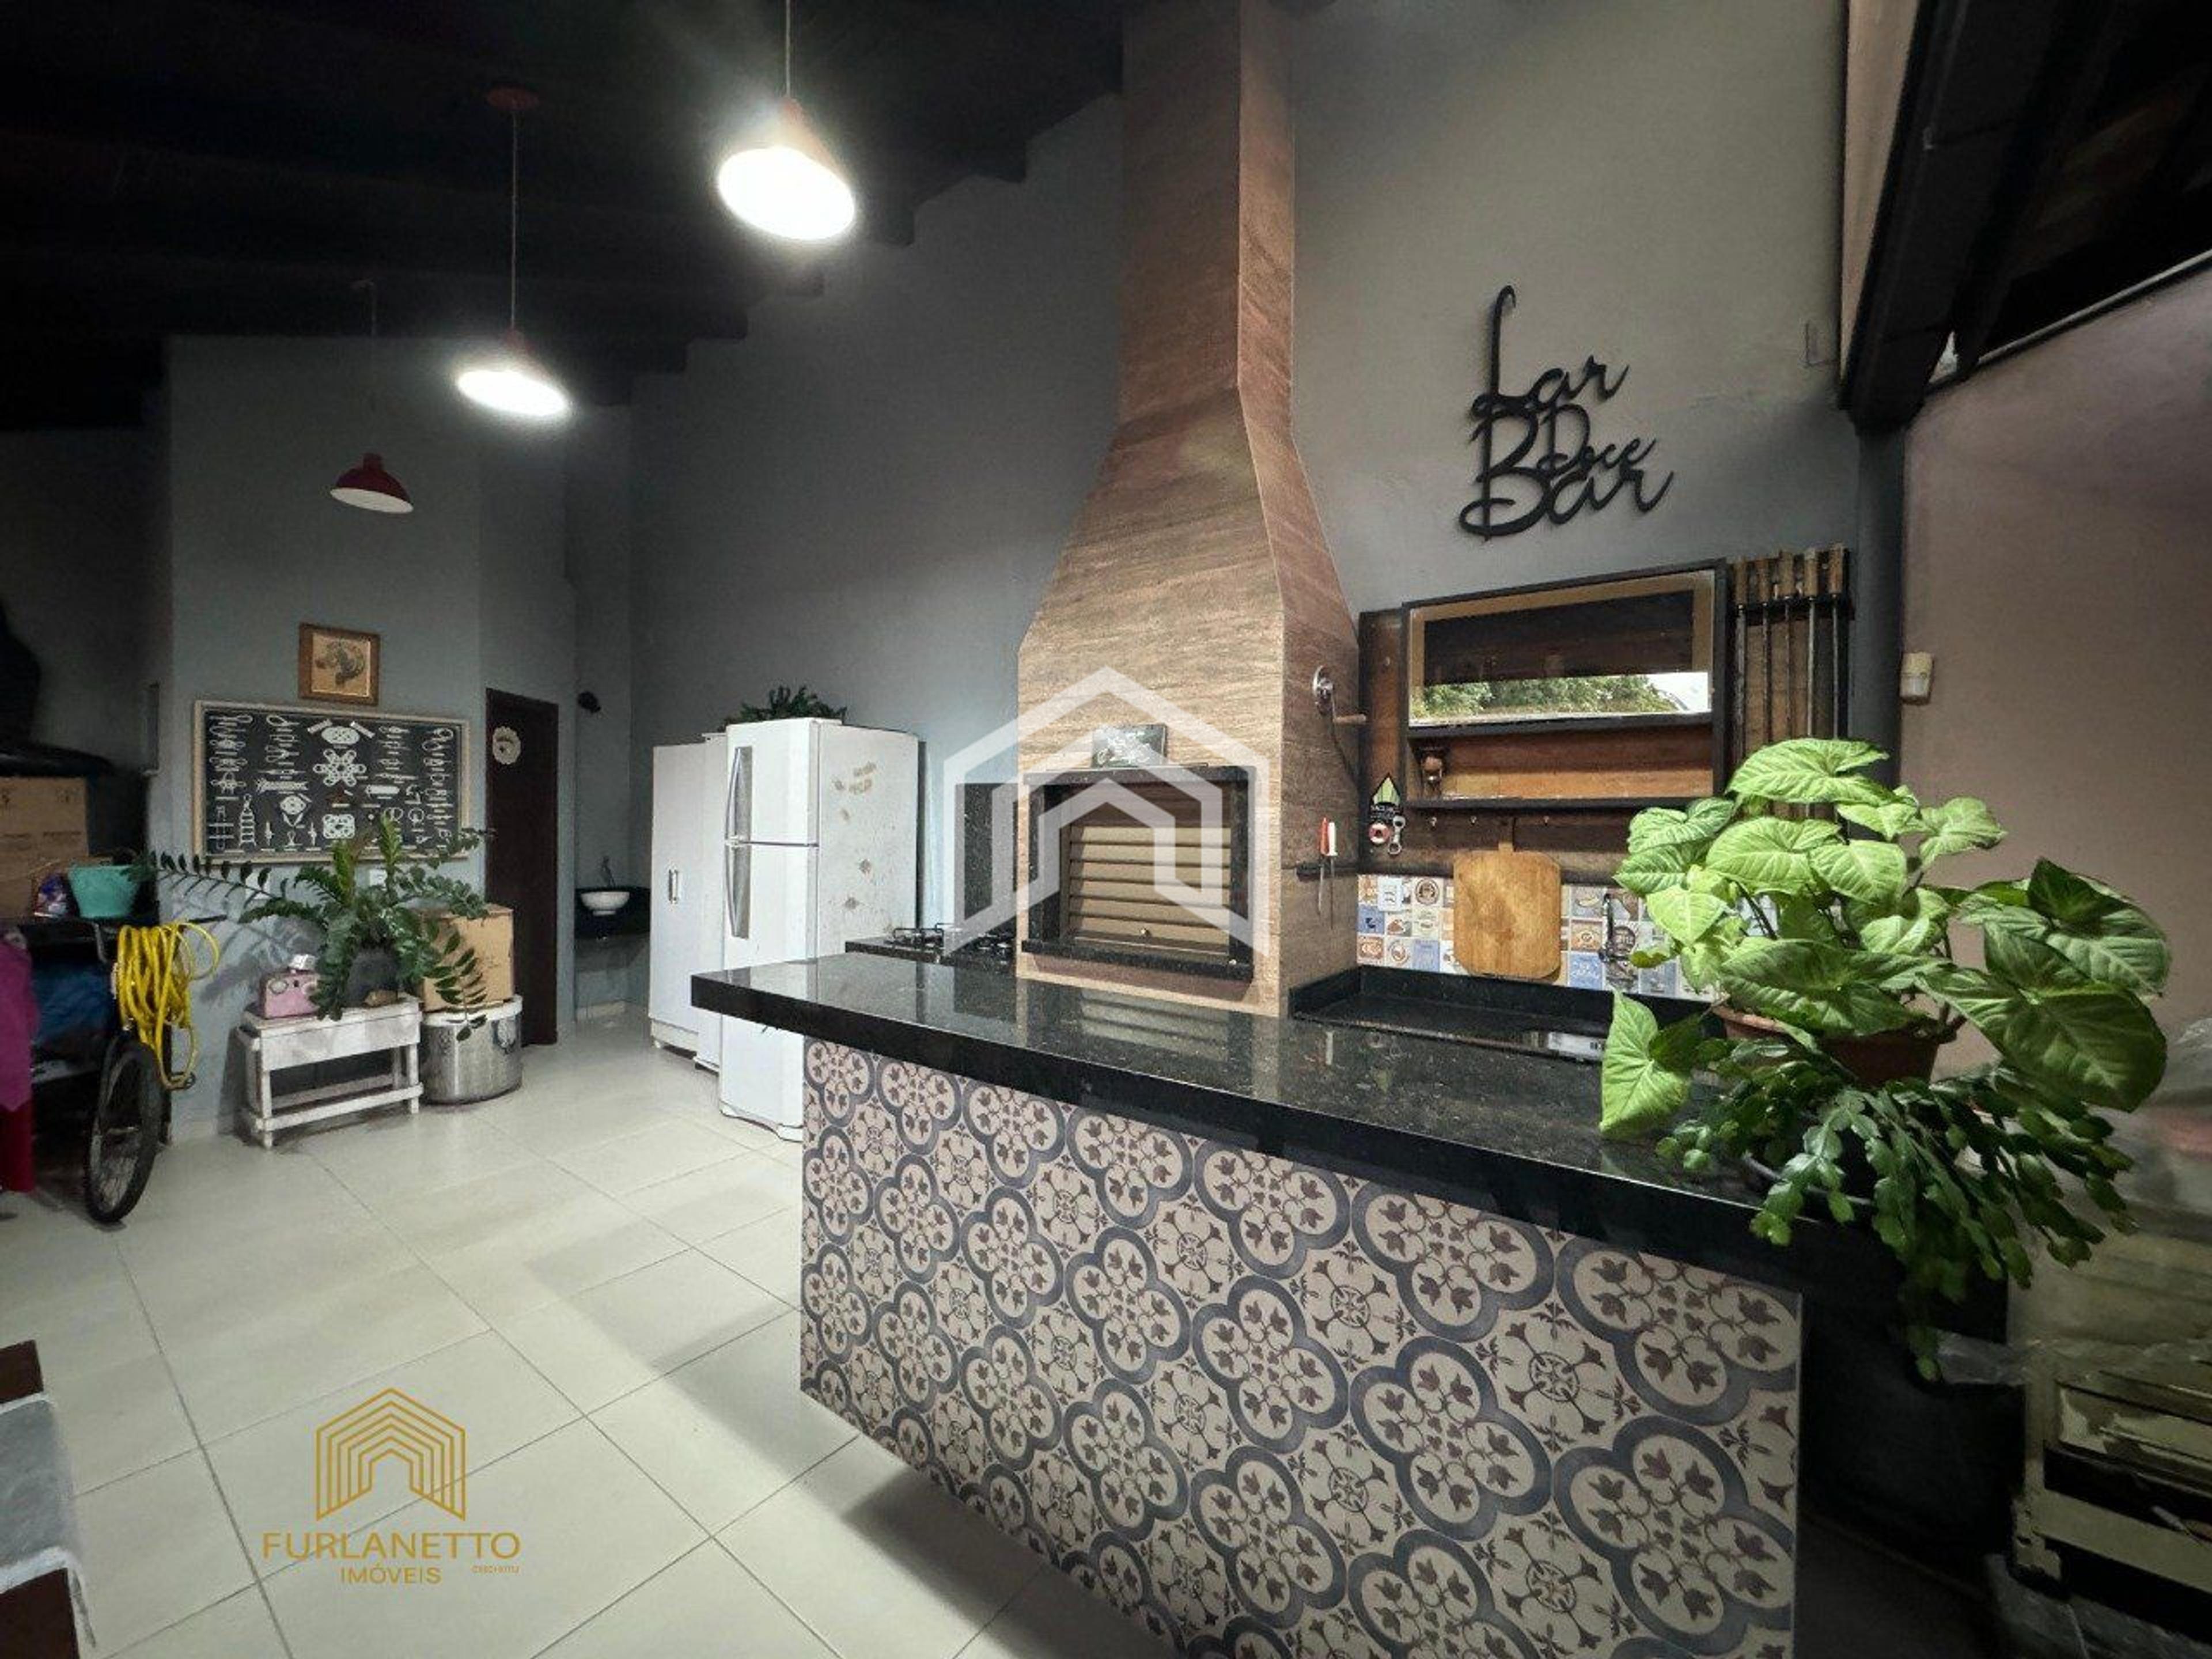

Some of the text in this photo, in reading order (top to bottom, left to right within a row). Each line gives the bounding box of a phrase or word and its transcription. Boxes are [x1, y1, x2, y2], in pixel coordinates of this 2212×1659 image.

[1471, 285, 1630, 420] Lar
[1459, 408, 1674, 541] Bar
[1537, 403, 1657, 478] Doce
